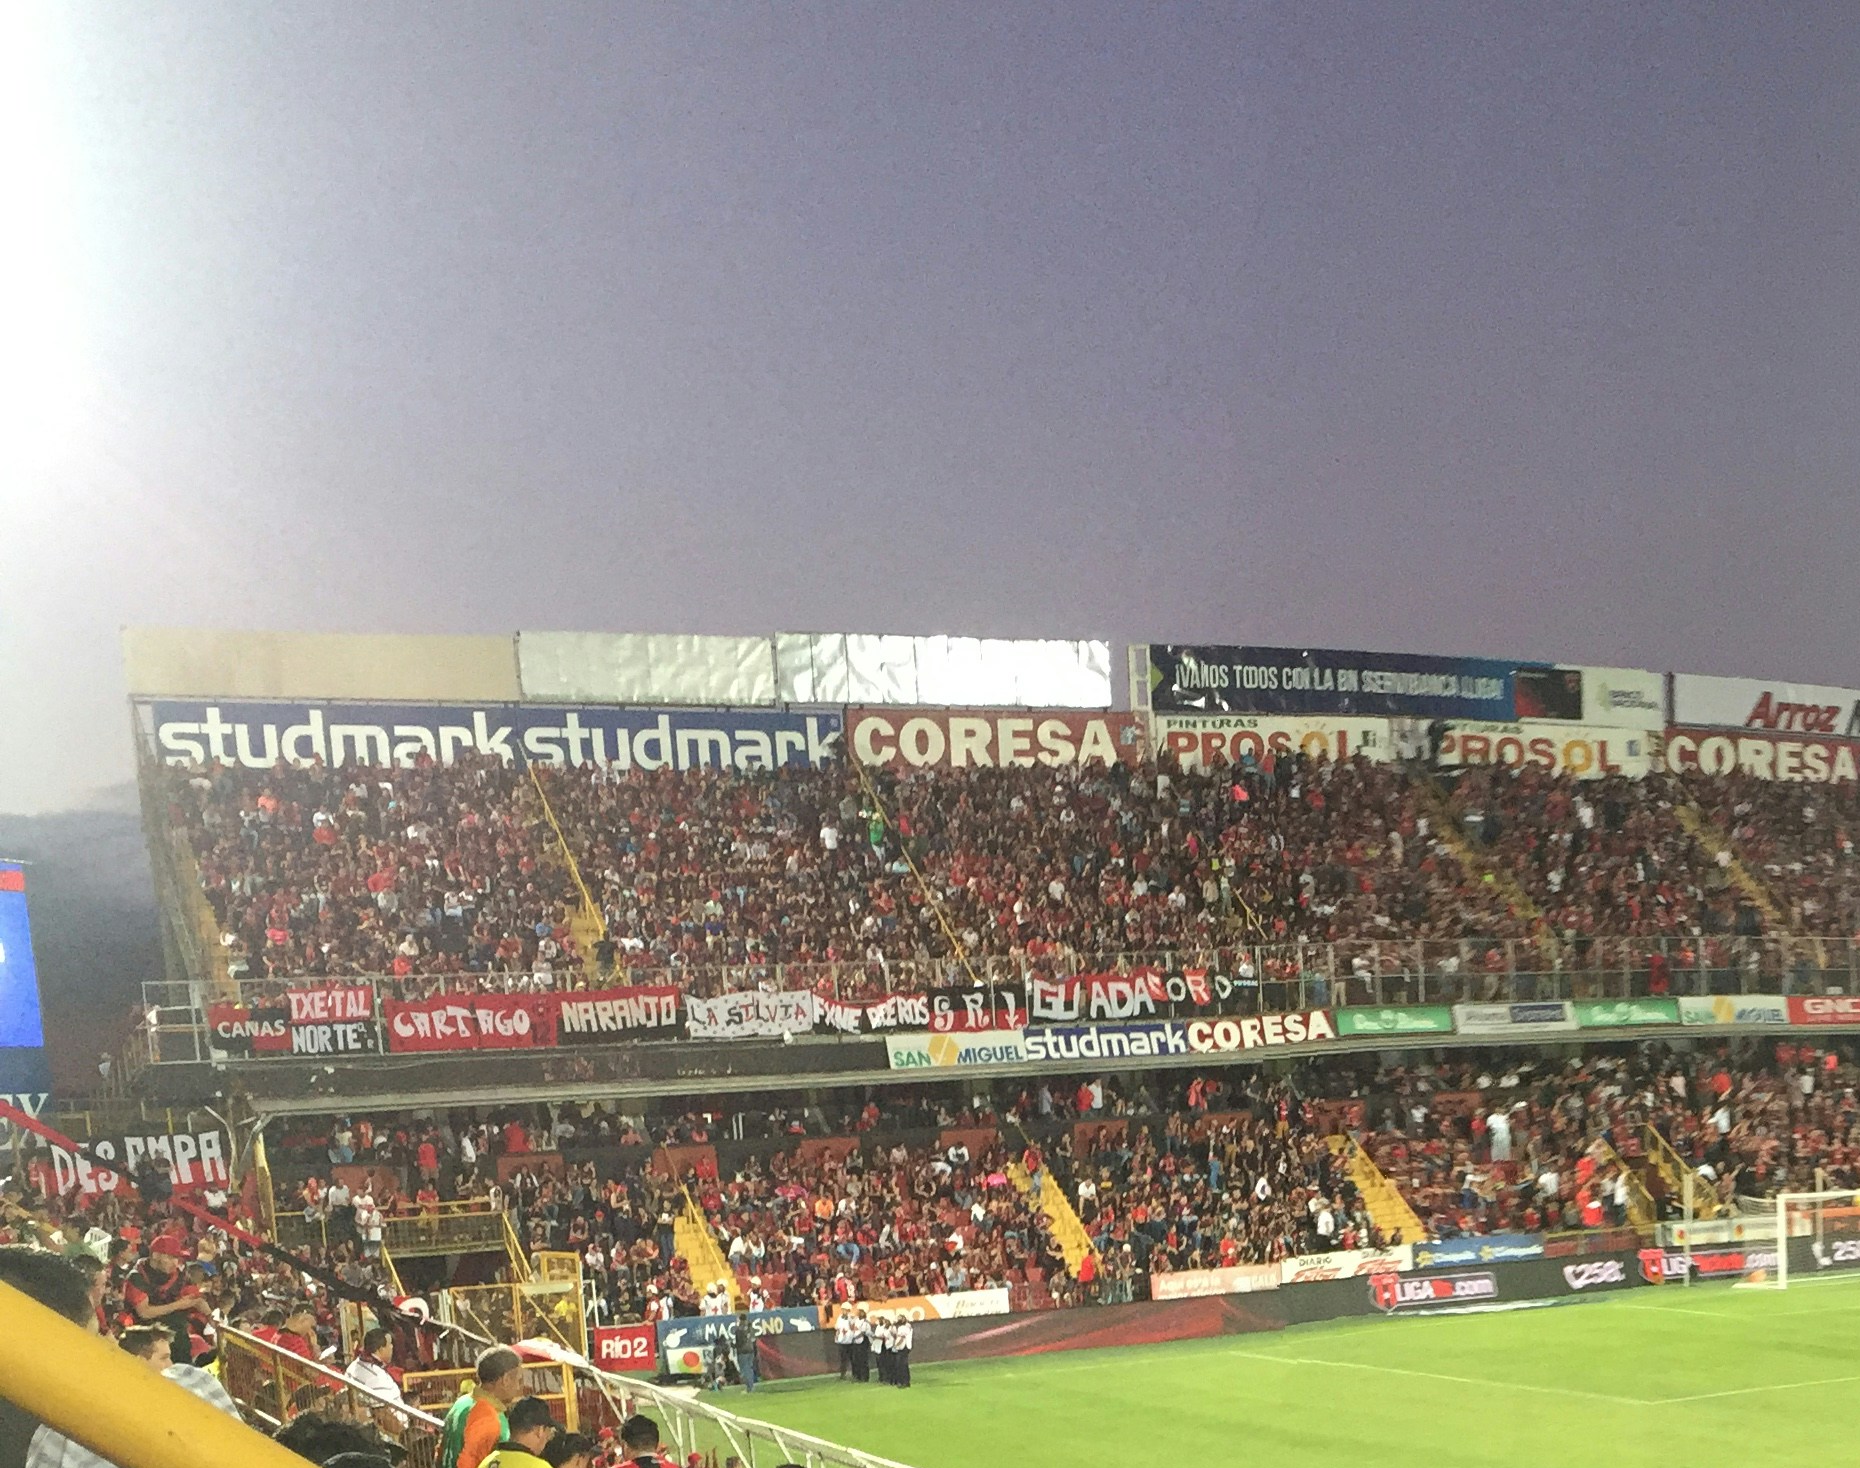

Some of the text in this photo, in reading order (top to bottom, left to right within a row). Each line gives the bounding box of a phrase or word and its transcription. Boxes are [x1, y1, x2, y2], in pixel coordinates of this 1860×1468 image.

[1233, 665, 1278, 690] TODOS
[1167, 717, 1258, 730] PINTURAS
[1746, 691, 1841, 734] Arroz
[158, 705, 514, 770] studmark
[522, 712, 839, 773] studmark
[853, 715, 1120, 769] CORESA
[1167, 728, 1351, 767] PROSOL
[1666, 734, 1860, 784] CORESA
[393, 1002, 531, 1041] CARTAGO
[561, 994, 678, 1034] NARANJO
[1188, 1014, 1336, 1052] CORESA
[291, 1023, 358, 1055] NORTE
[894, 1044, 1025, 1067] SAN MIGUEL
[1026, 1022, 1187, 1060] studmark
[601, 1333, 648, 1359] RÍO 2
